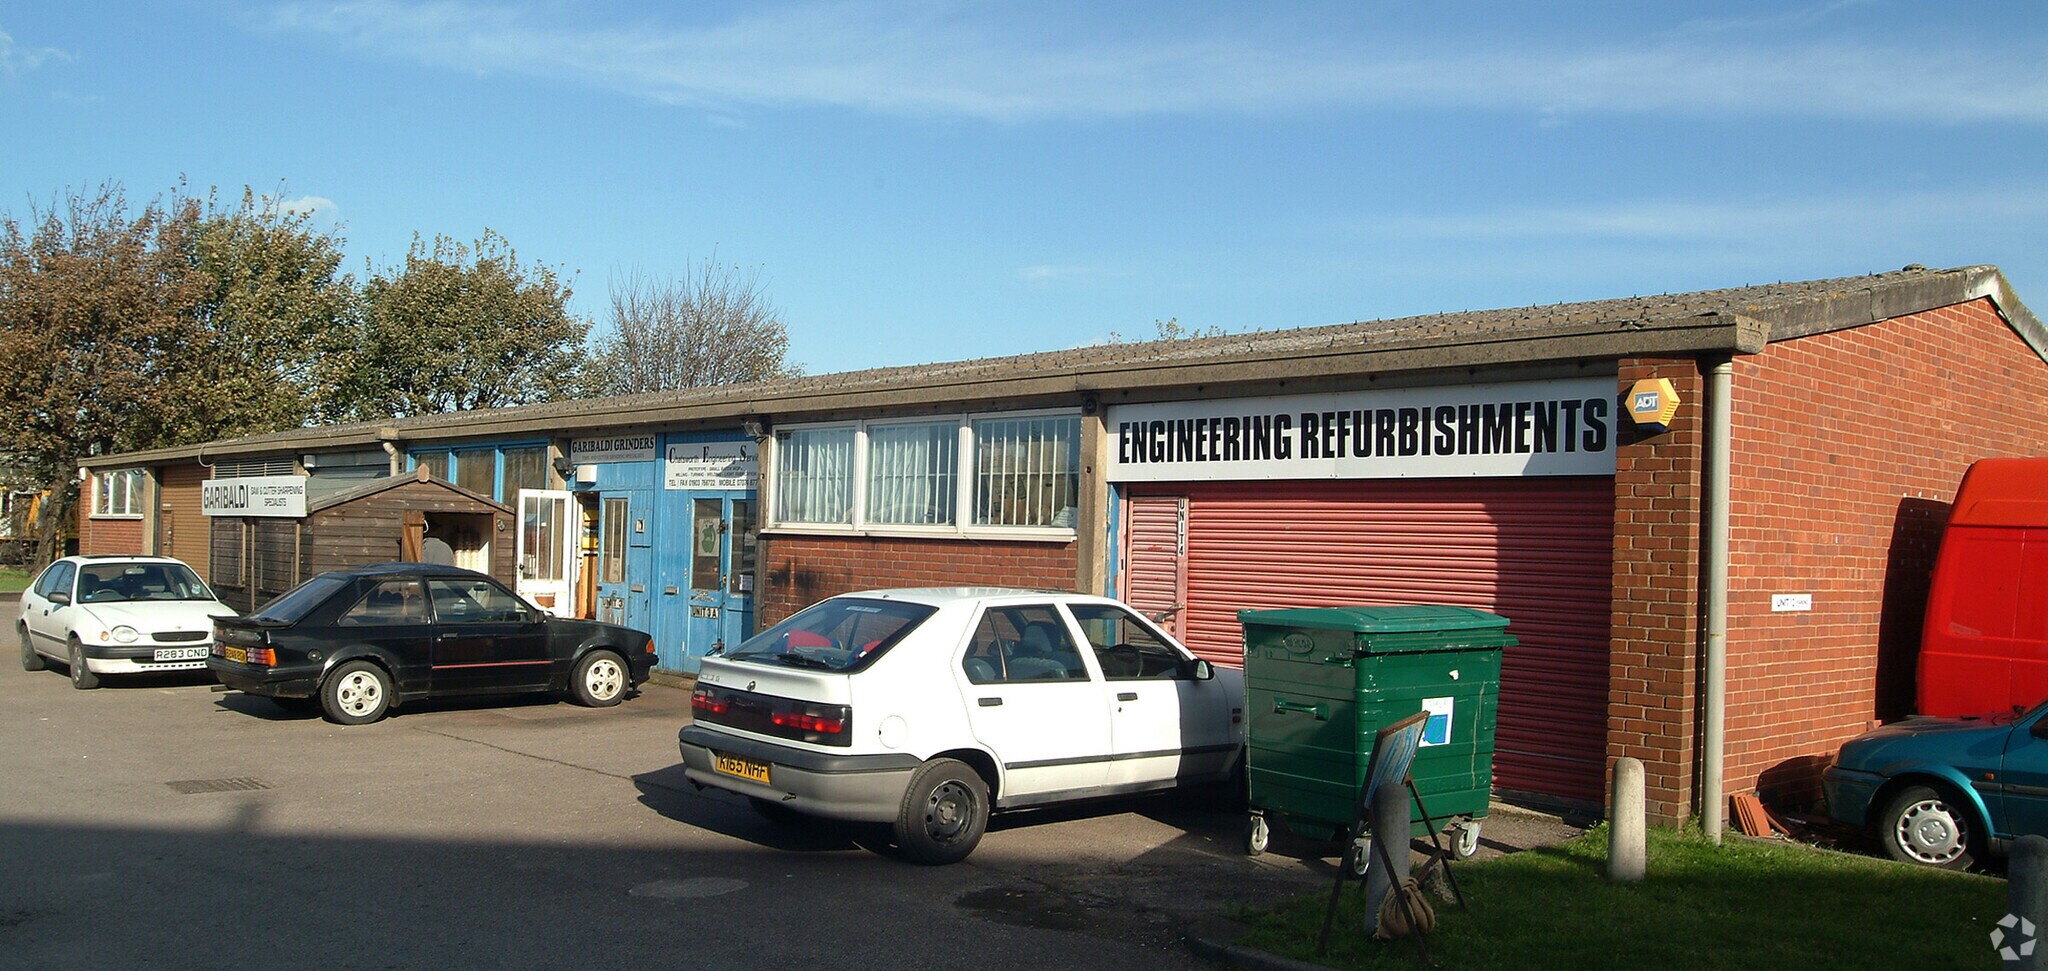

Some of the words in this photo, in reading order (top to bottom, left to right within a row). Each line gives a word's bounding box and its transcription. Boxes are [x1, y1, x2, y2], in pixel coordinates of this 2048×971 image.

[1635, 396, 1658, 408] ADT
[1118, 413, 1292, 464] ENGINEERING
[1300, 398, 1608, 460] REFURBISHMENTS
[572, 439, 613, 453] GARIBALDI
[614, 437, 655, 451] GRINDERS
[669, 447, 699, 464] Chatsworth
[702, 446, 736, 465] Engineering
[668, 479, 677, 487] TEL
[680, 479, 688, 487] FAX
[719, 479, 736, 487] MOBILE
[250, 486, 259, 496] SAW
[263, 486, 277, 495] CUTTER
[277, 485, 303, 495] SHARPENING
[203, 484, 249, 509] GARIBALDI
[264, 497, 287, 507] SPECIALISTS
[1179, 545, 1184, 556] 4
[618, 599, 623, 608] 3
[156, 649, 185, 659] R283
[187, 648, 208, 658] CND
[719, 756, 743, 773] K165
[744, 760, 768, 778] NHF
